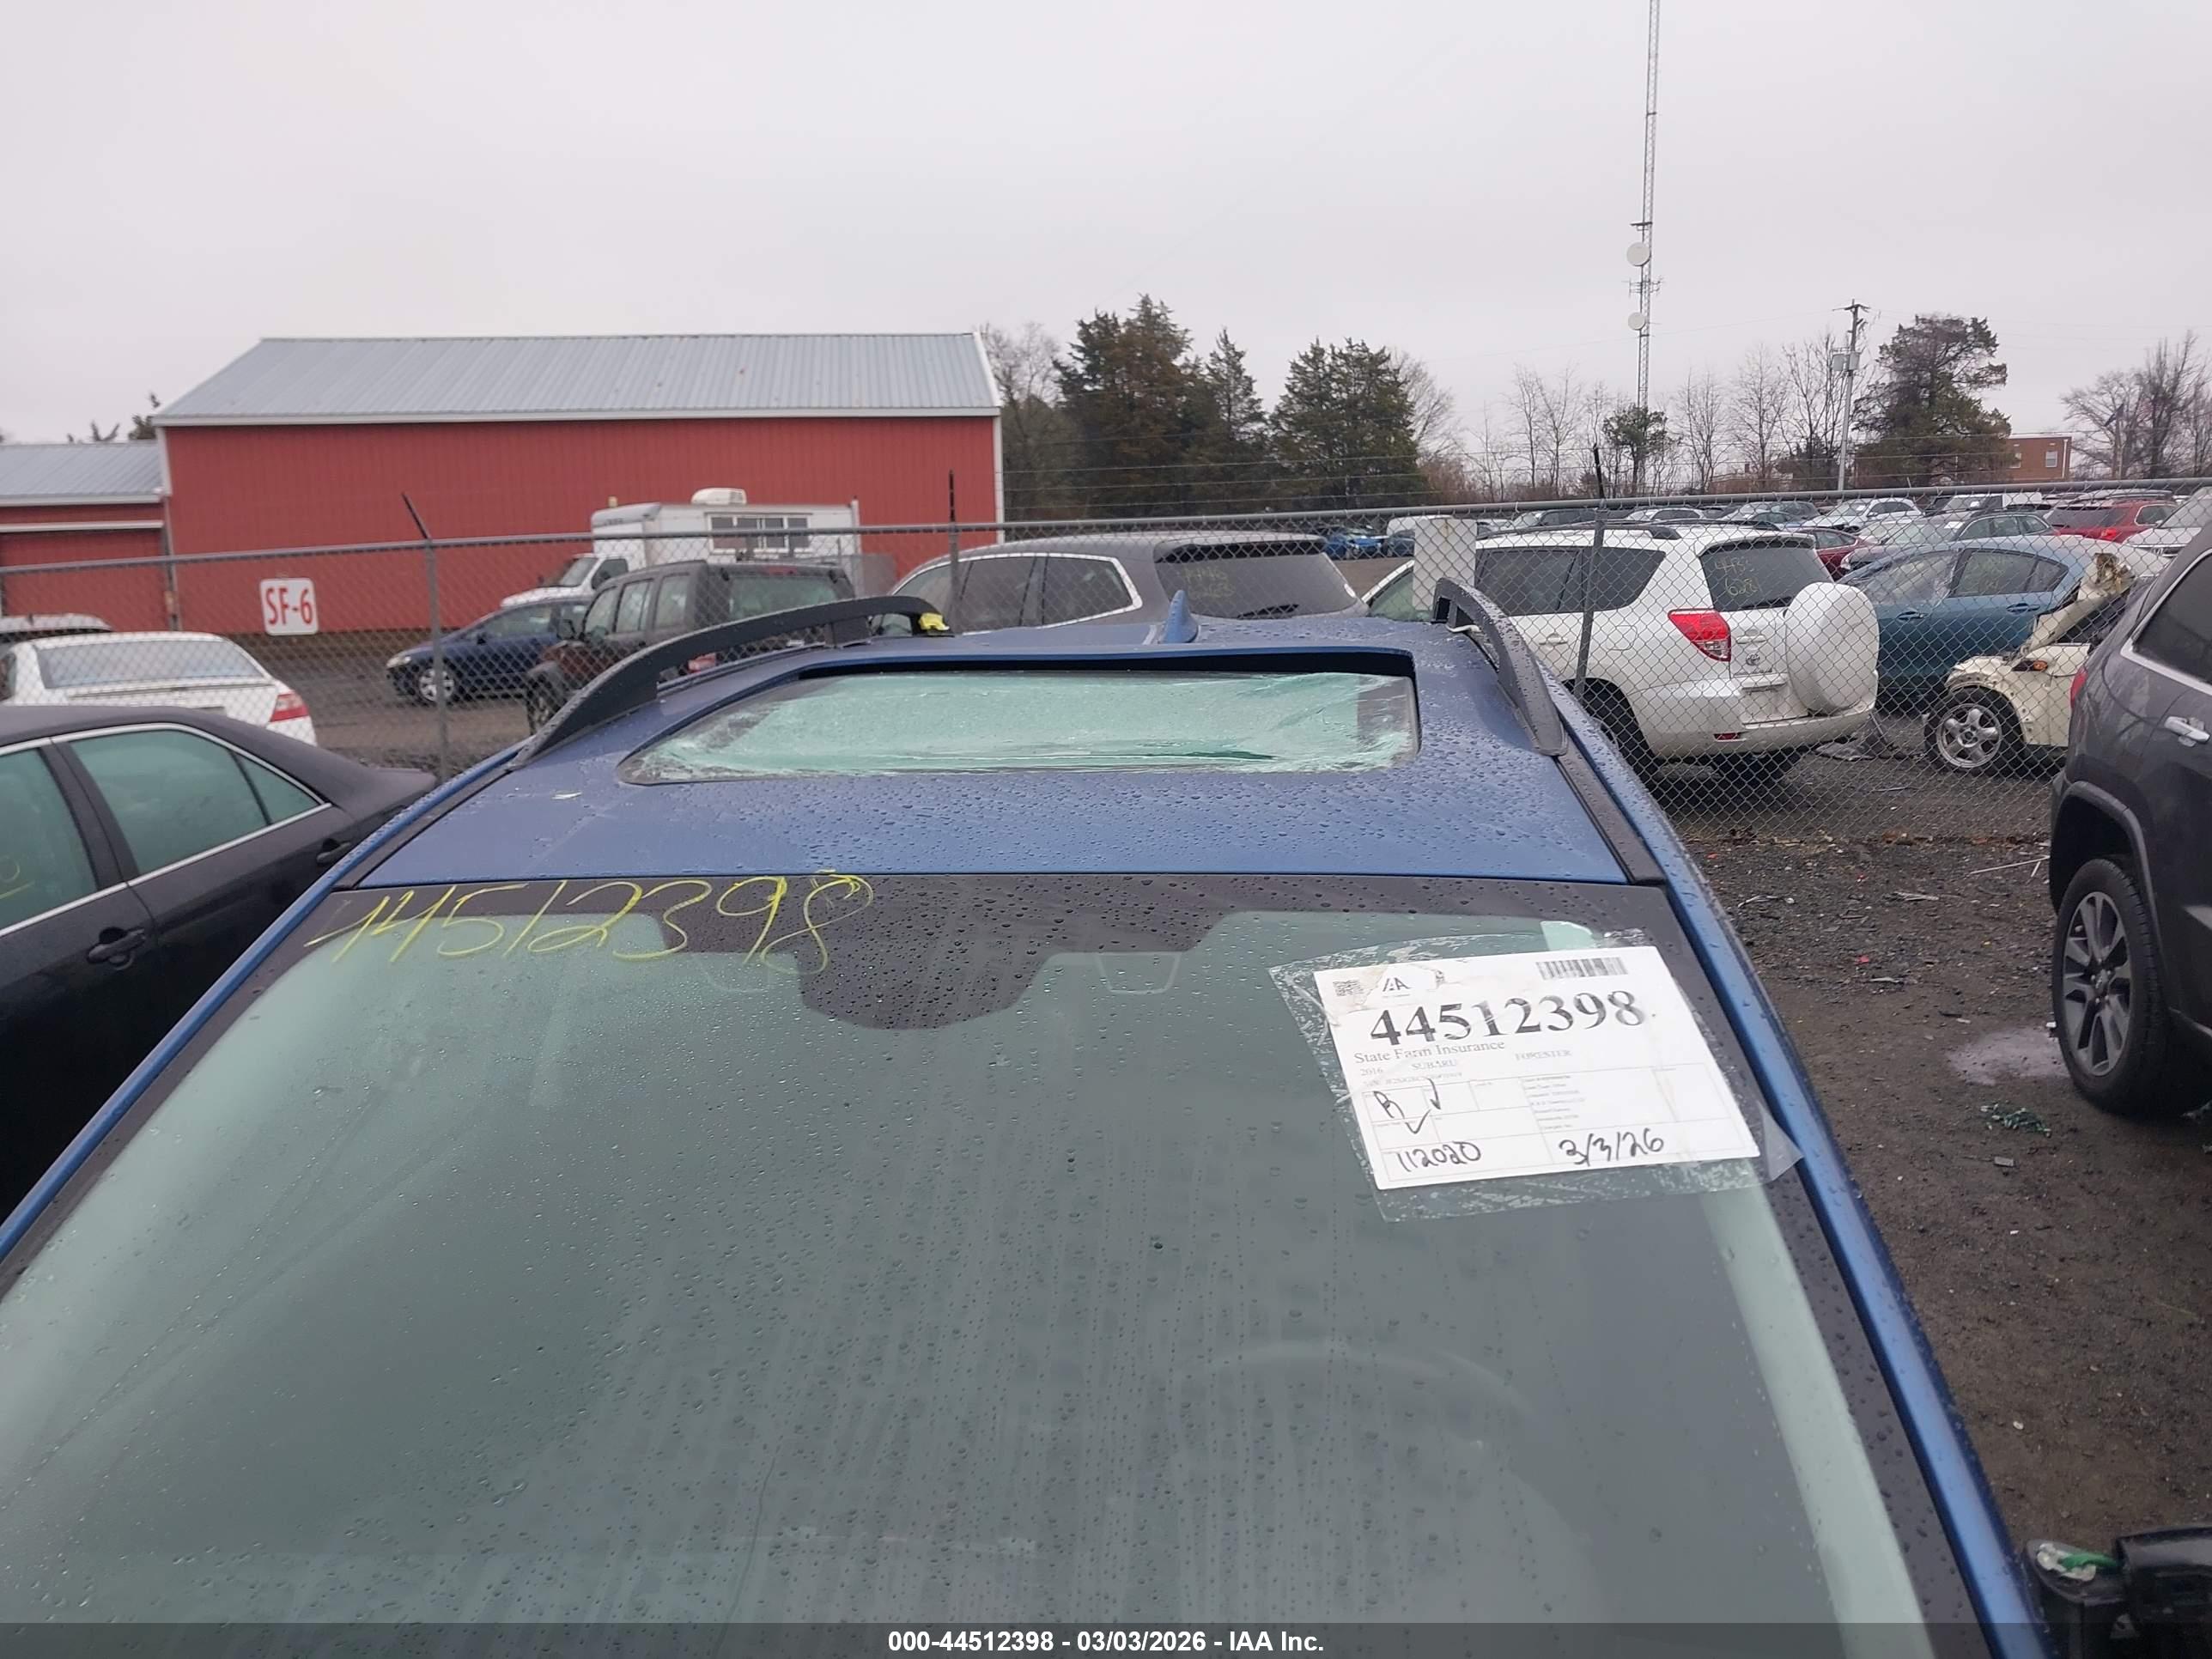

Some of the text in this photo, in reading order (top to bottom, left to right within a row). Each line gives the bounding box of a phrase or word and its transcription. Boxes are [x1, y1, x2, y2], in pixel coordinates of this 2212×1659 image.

[265, 587, 313, 625] SF-6
[1370, 990, 1645, 1046] 44512398
[1354, 1052, 1390, 1064] State
[1436, 1042, 1505, 1055] Insurance
[1559, 1127, 1664, 1167] 3/3/26
